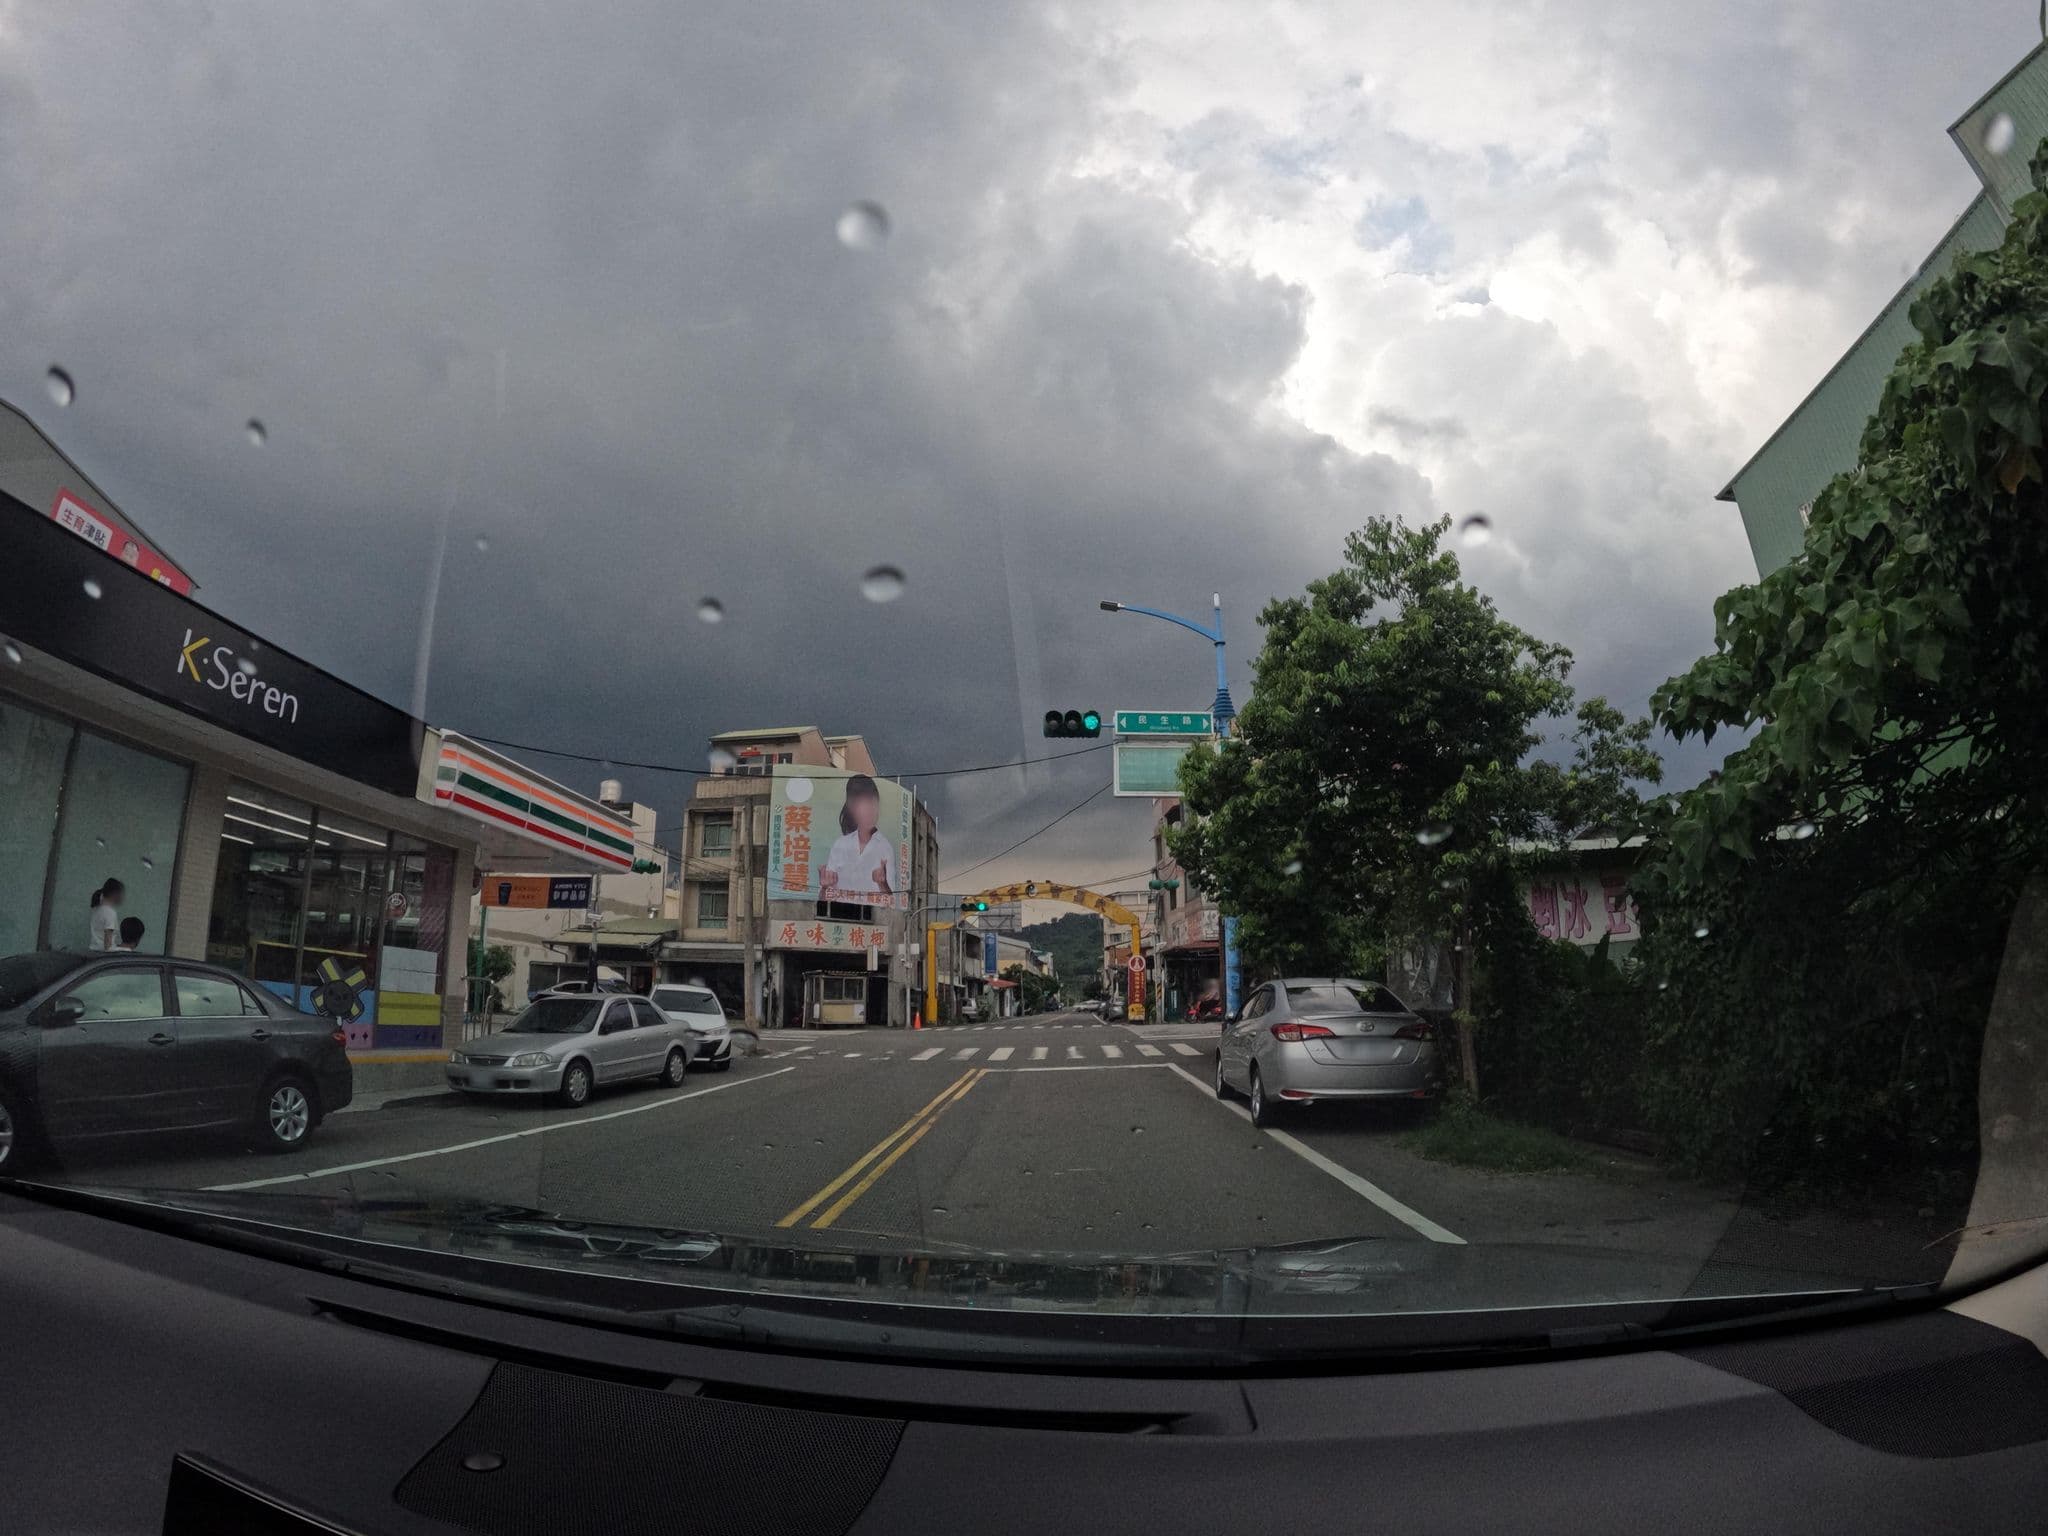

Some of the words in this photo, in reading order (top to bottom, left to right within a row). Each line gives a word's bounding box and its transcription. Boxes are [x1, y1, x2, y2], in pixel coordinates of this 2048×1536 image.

[61, 508, 106, 546] 生育津貼
[1138, 715, 1192, 726] 民生路
[782, 805, 812, 892] 蔡培慧
